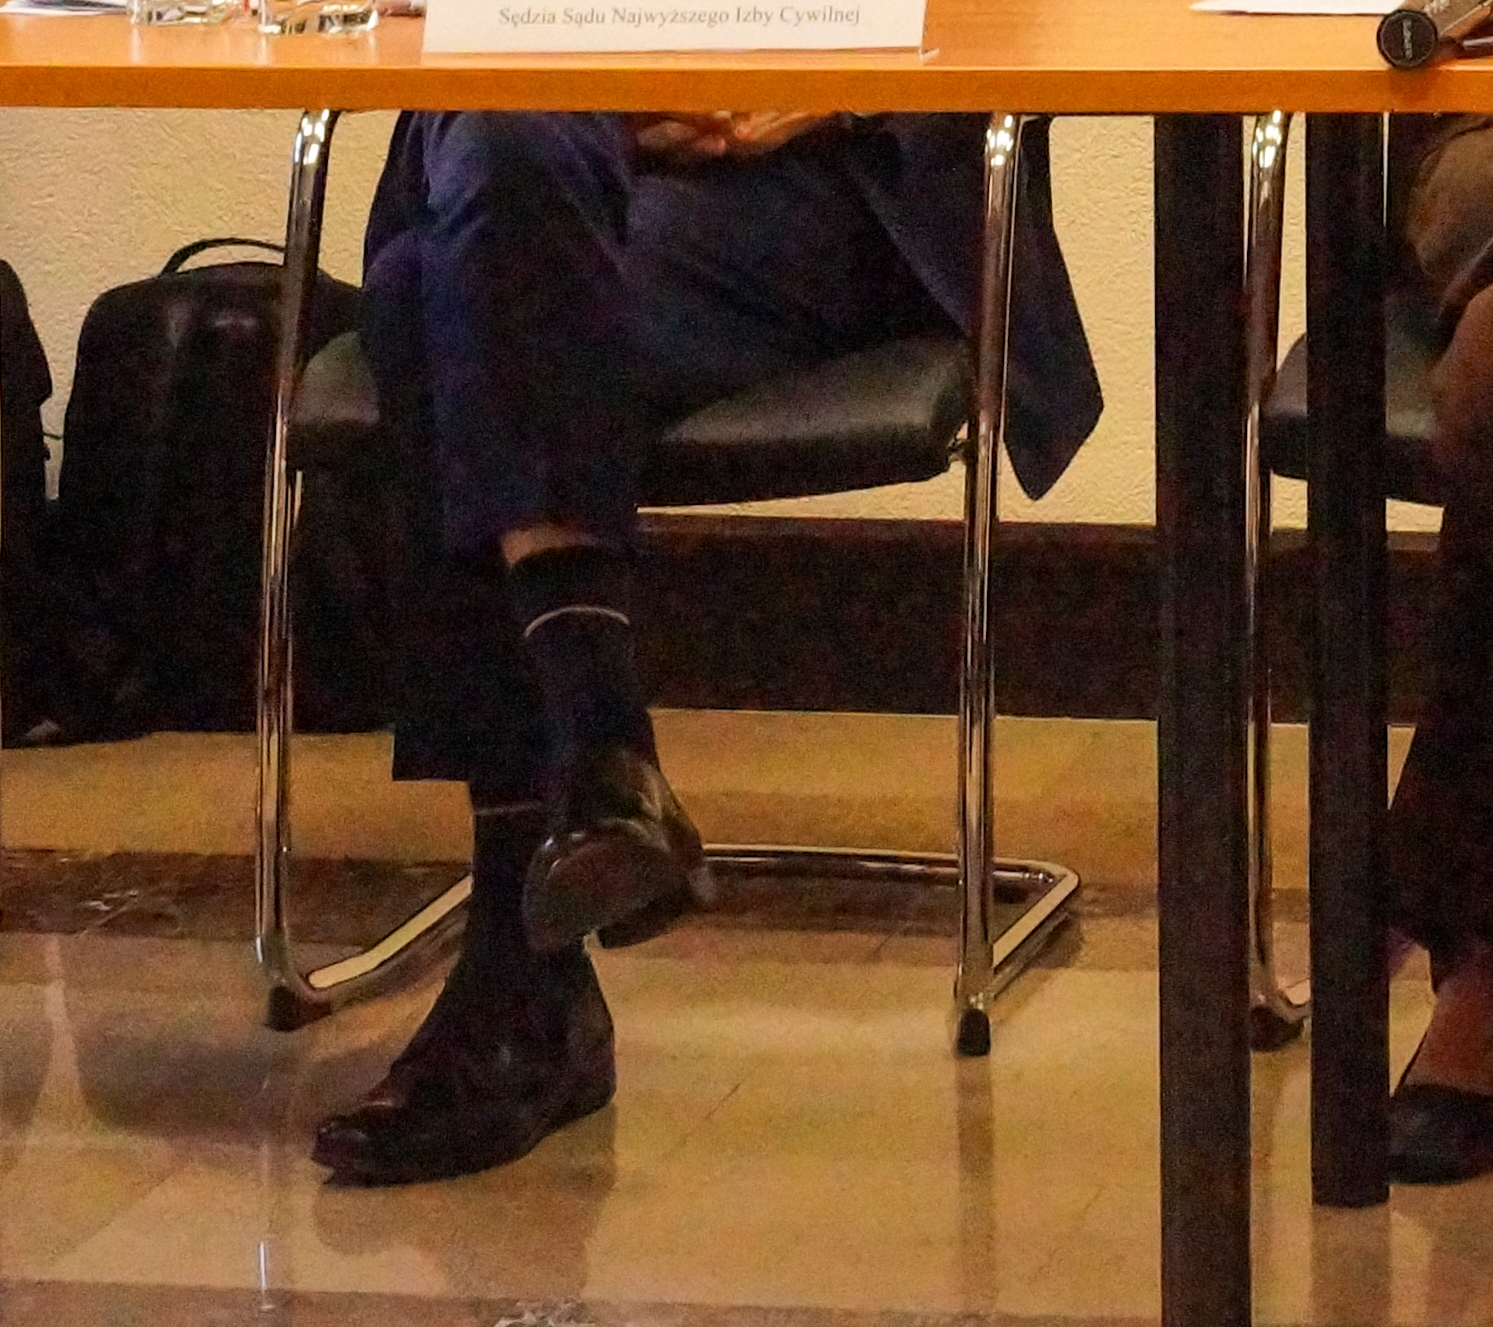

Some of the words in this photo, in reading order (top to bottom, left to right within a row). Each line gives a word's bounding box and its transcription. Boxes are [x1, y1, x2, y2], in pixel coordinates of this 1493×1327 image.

[499, 7, 556, 28] Sędzia
[562, 7, 606, 28] Sądu
[612, 7, 730, 29] Najwyższego
[735, 6, 774, 27] Izby
[779, 5, 861, 28] Cywilnej
